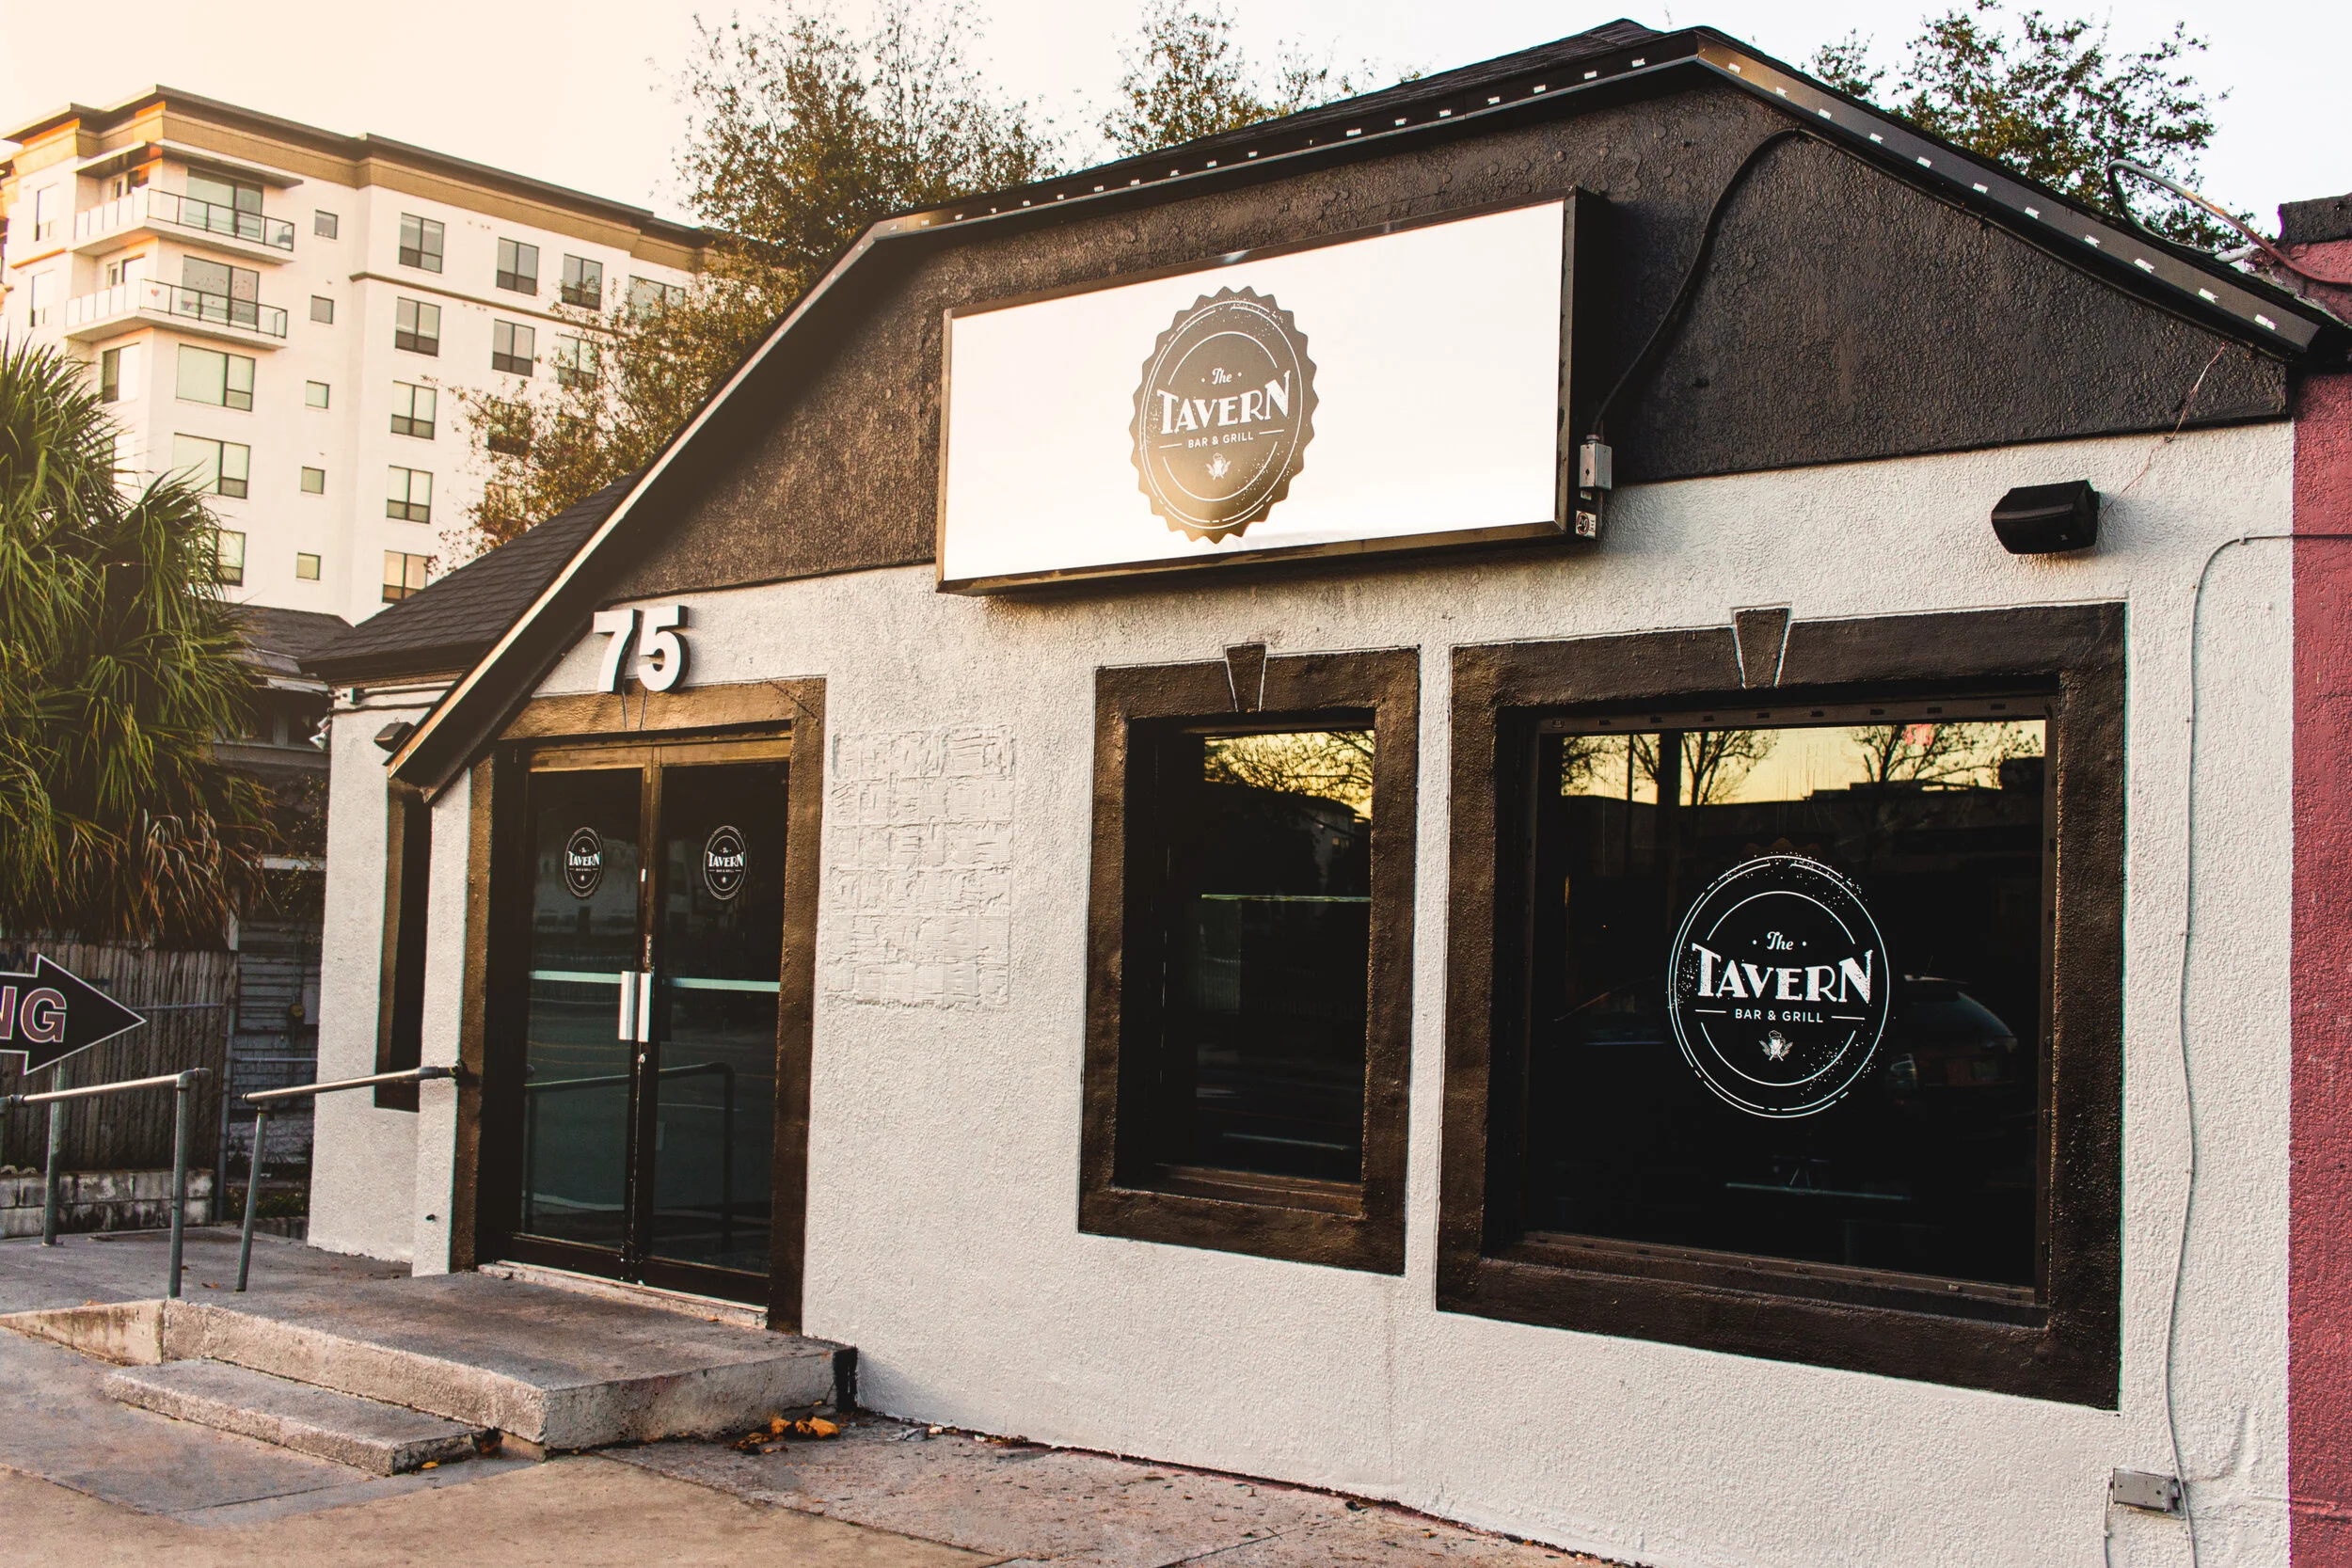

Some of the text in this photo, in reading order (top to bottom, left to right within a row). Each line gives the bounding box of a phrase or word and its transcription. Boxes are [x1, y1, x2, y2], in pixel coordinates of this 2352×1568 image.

[1212, 367, 1232, 385] The
[1156, 370, 1291, 435] TAVERN
[1188, 431, 1254, 449] BAR & GRILL
[593, 605, 691, 693] 75
[568, 850, 601, 866] TAVERN
[707, 850, 744, 867] TAVERN
[1766, 931, 1794, 951] The
[1692, 942, 1874, 1005] TAVERN
[1734, 1008, 1824, 1023] BAR & GRILL
